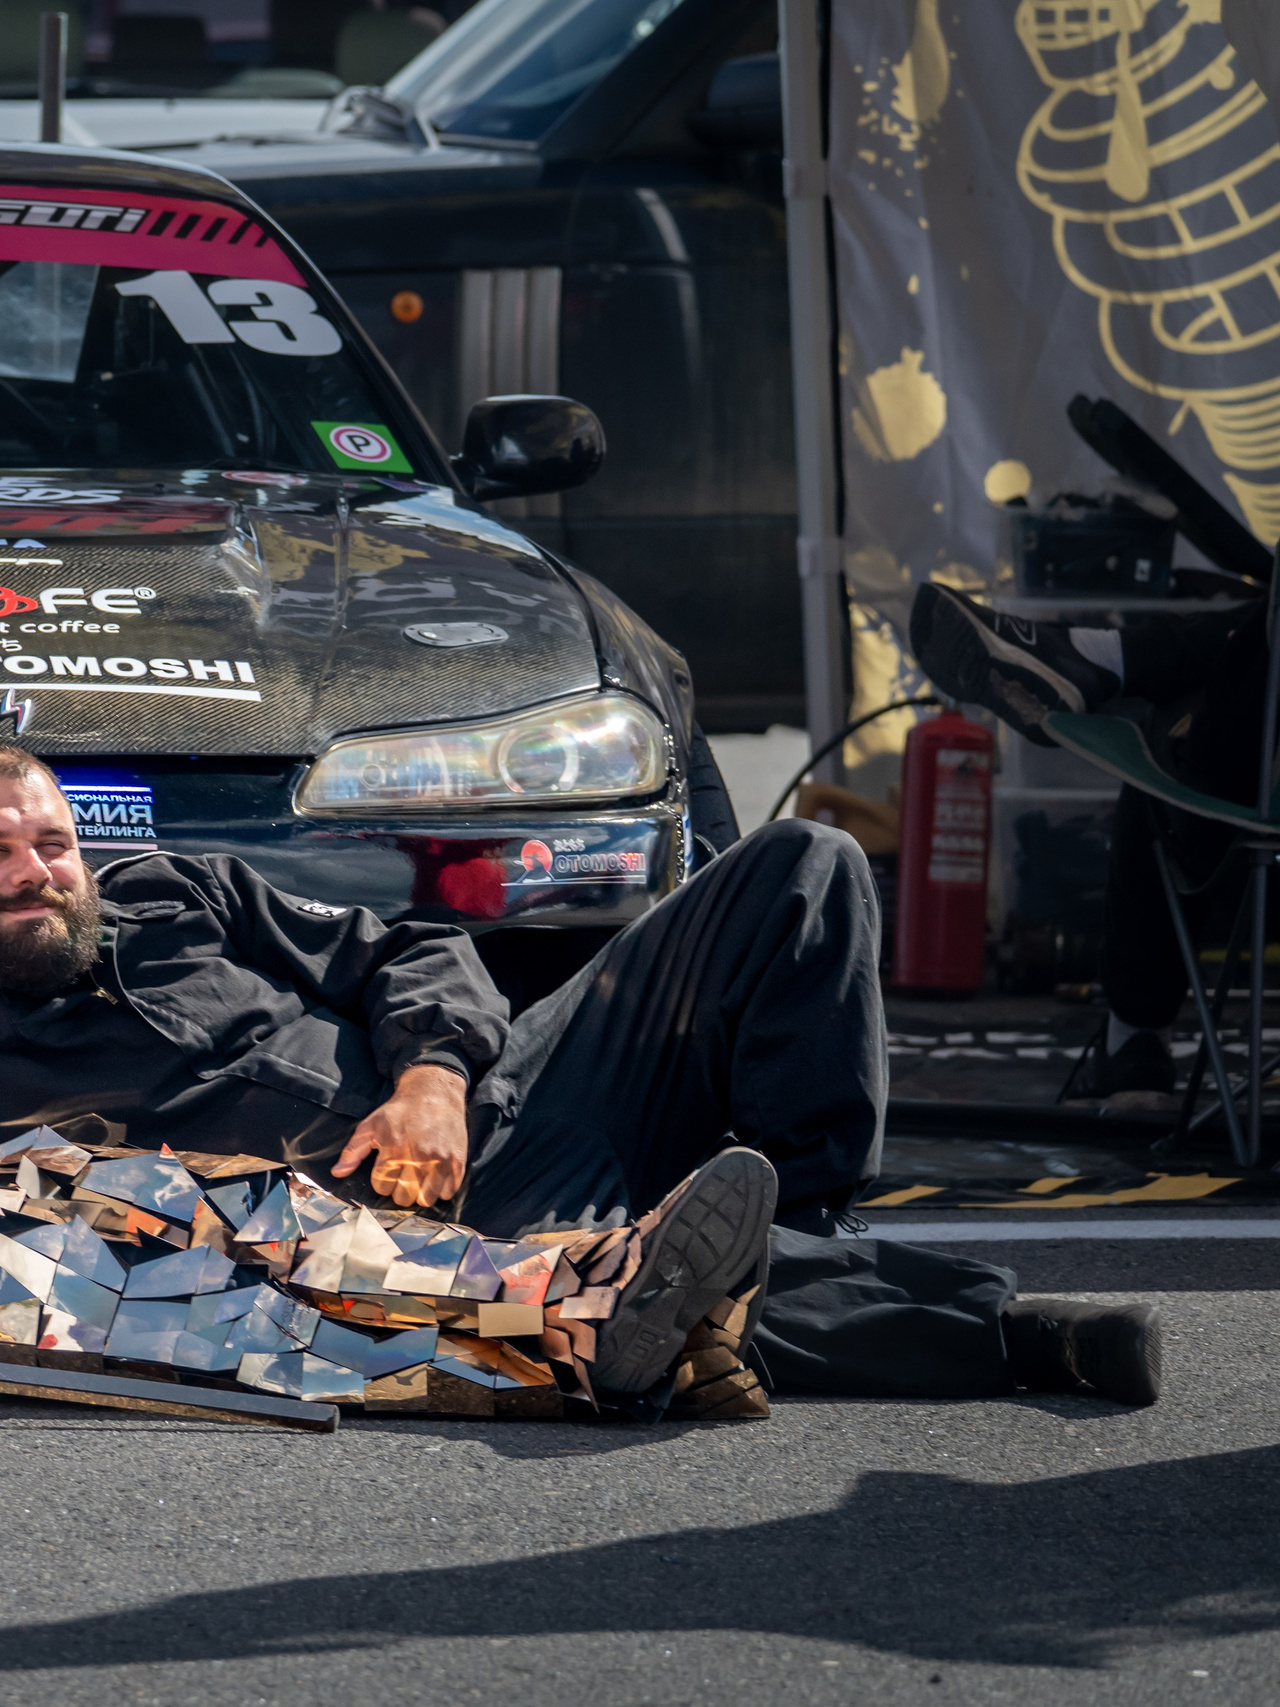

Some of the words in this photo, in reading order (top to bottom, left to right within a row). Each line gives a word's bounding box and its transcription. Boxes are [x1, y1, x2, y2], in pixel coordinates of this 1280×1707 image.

[115, 269, 343, 357] 13
[345, 434, 371, 453] P
[20, 620, 121, 634] coffee
[67, 793, 154, 804] СИОНАЛЬНАЯ
[71, 802, 154, 825] МИЯ
[75, 823, 157, 838] ТЕЙЛИНГА
[554, 853, 647, 873] OTOMOSHI
